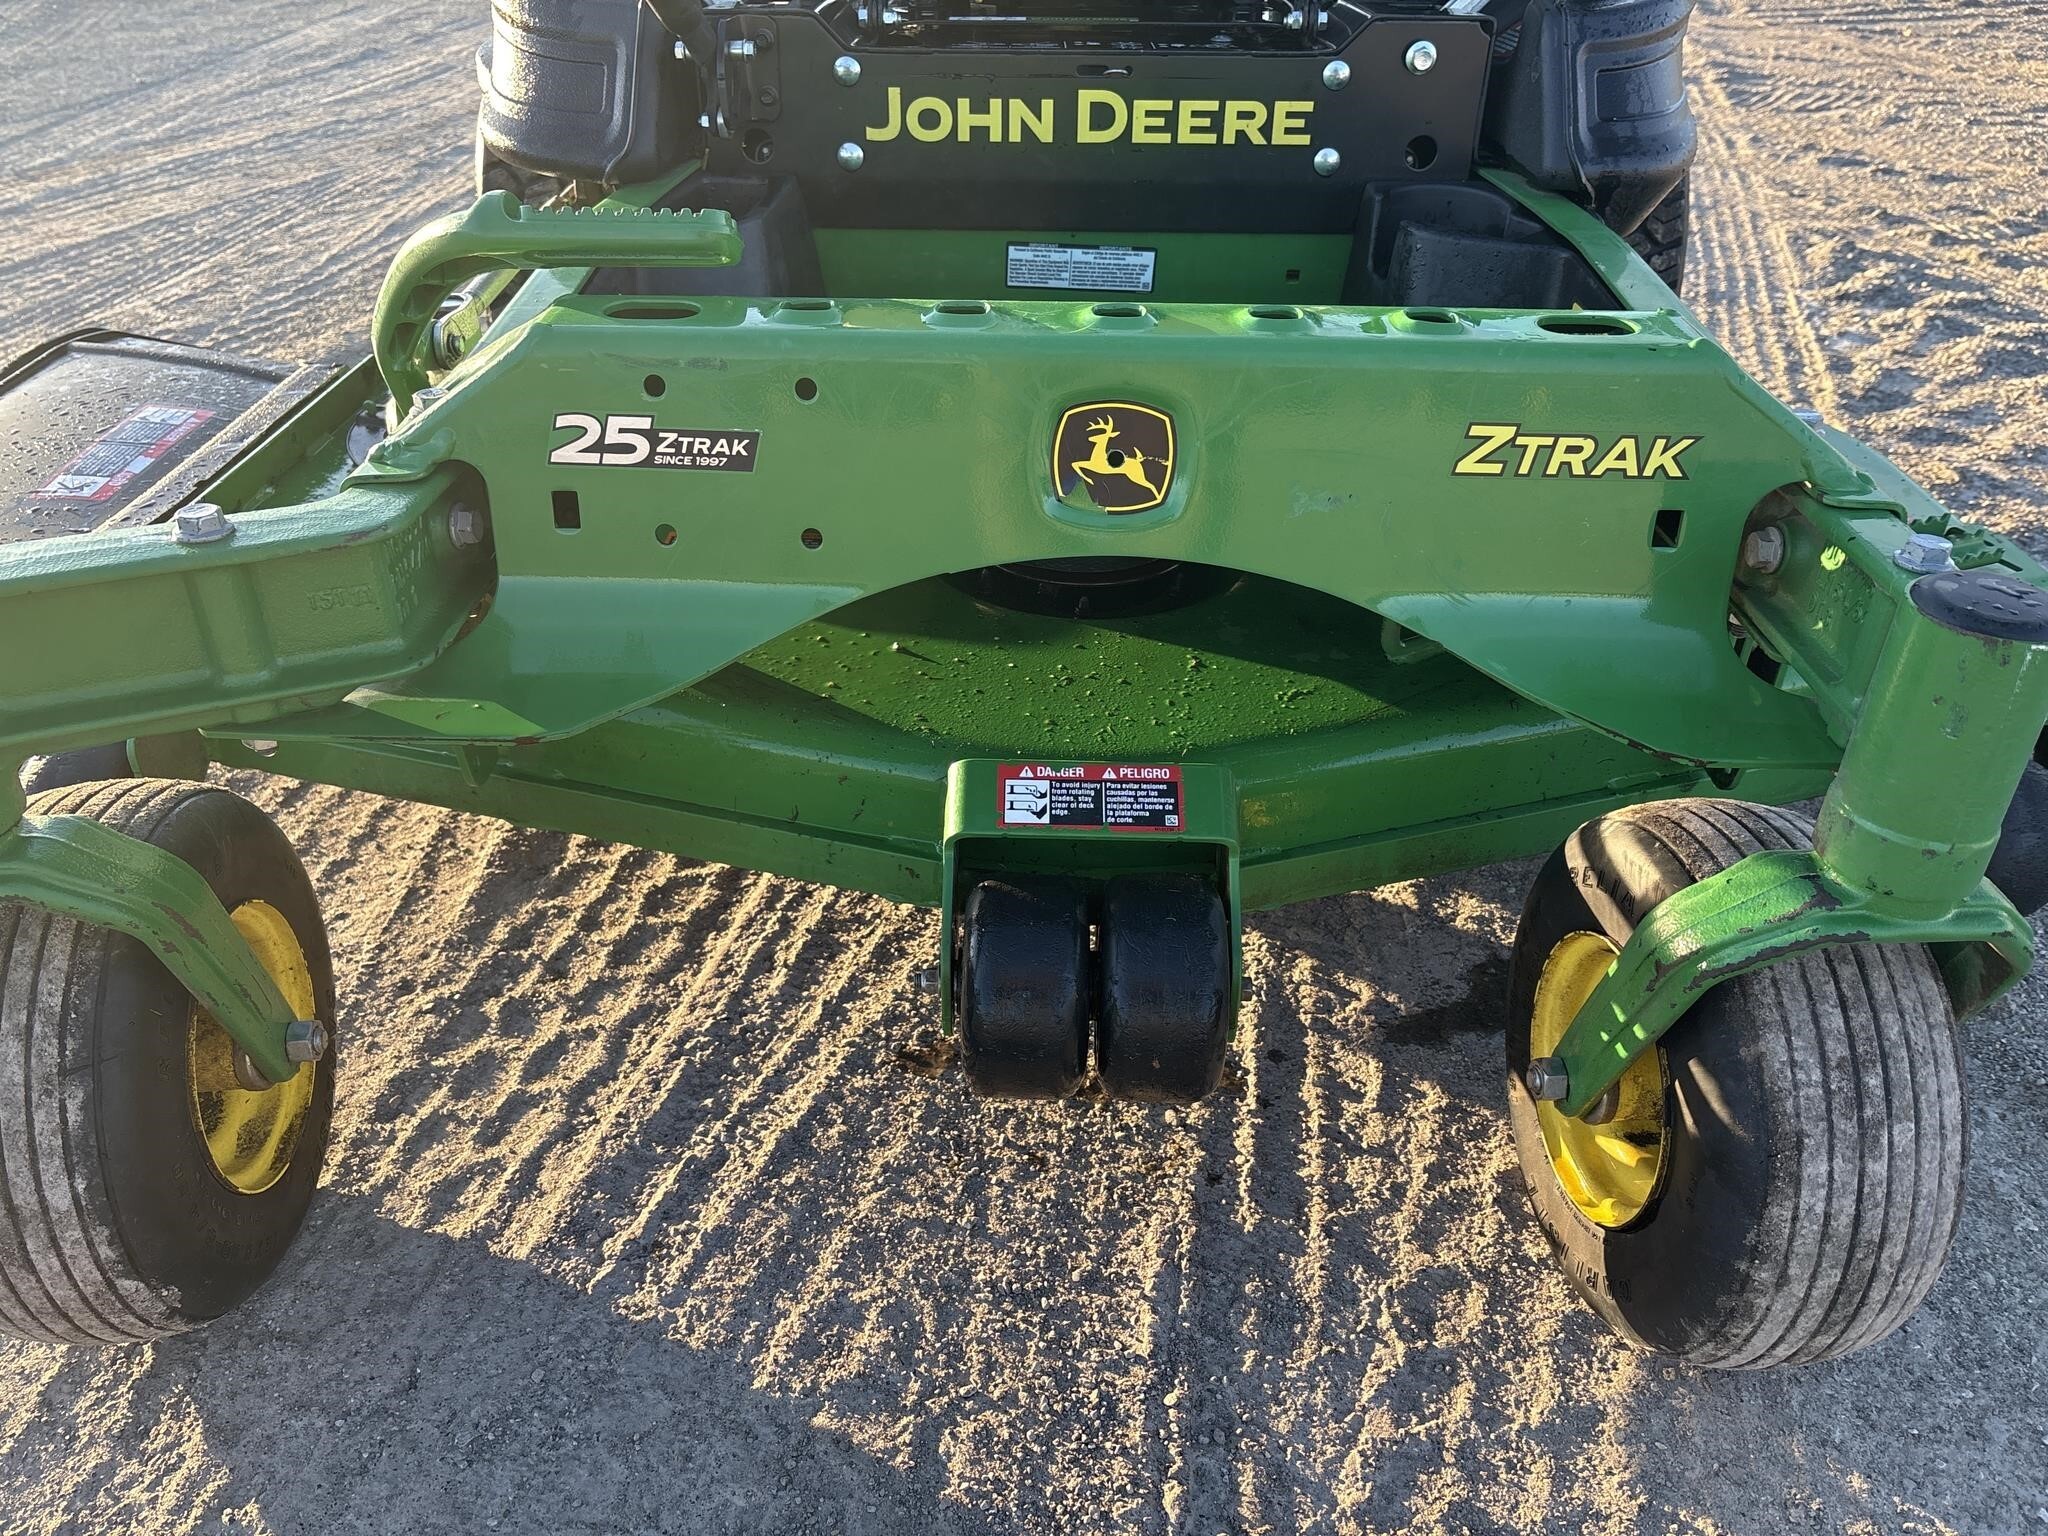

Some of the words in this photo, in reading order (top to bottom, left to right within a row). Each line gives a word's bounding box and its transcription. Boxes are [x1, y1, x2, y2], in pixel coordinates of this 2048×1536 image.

[865, 87, 1054, 143] JOHN
[1077, 89, 1315, 145] DEERE
[550, 414, 652, 465] 25
[655, 432, 750, 456] ZTRAK
[1453, 424, 1700, 479] ZTRAK
[654, 455, 693, 466] SINCE
[696, 456, 728, 467] 1997
[1082, 782, 1100, 790] injury
[1120, 768, 1170, 778] PELIGRO
